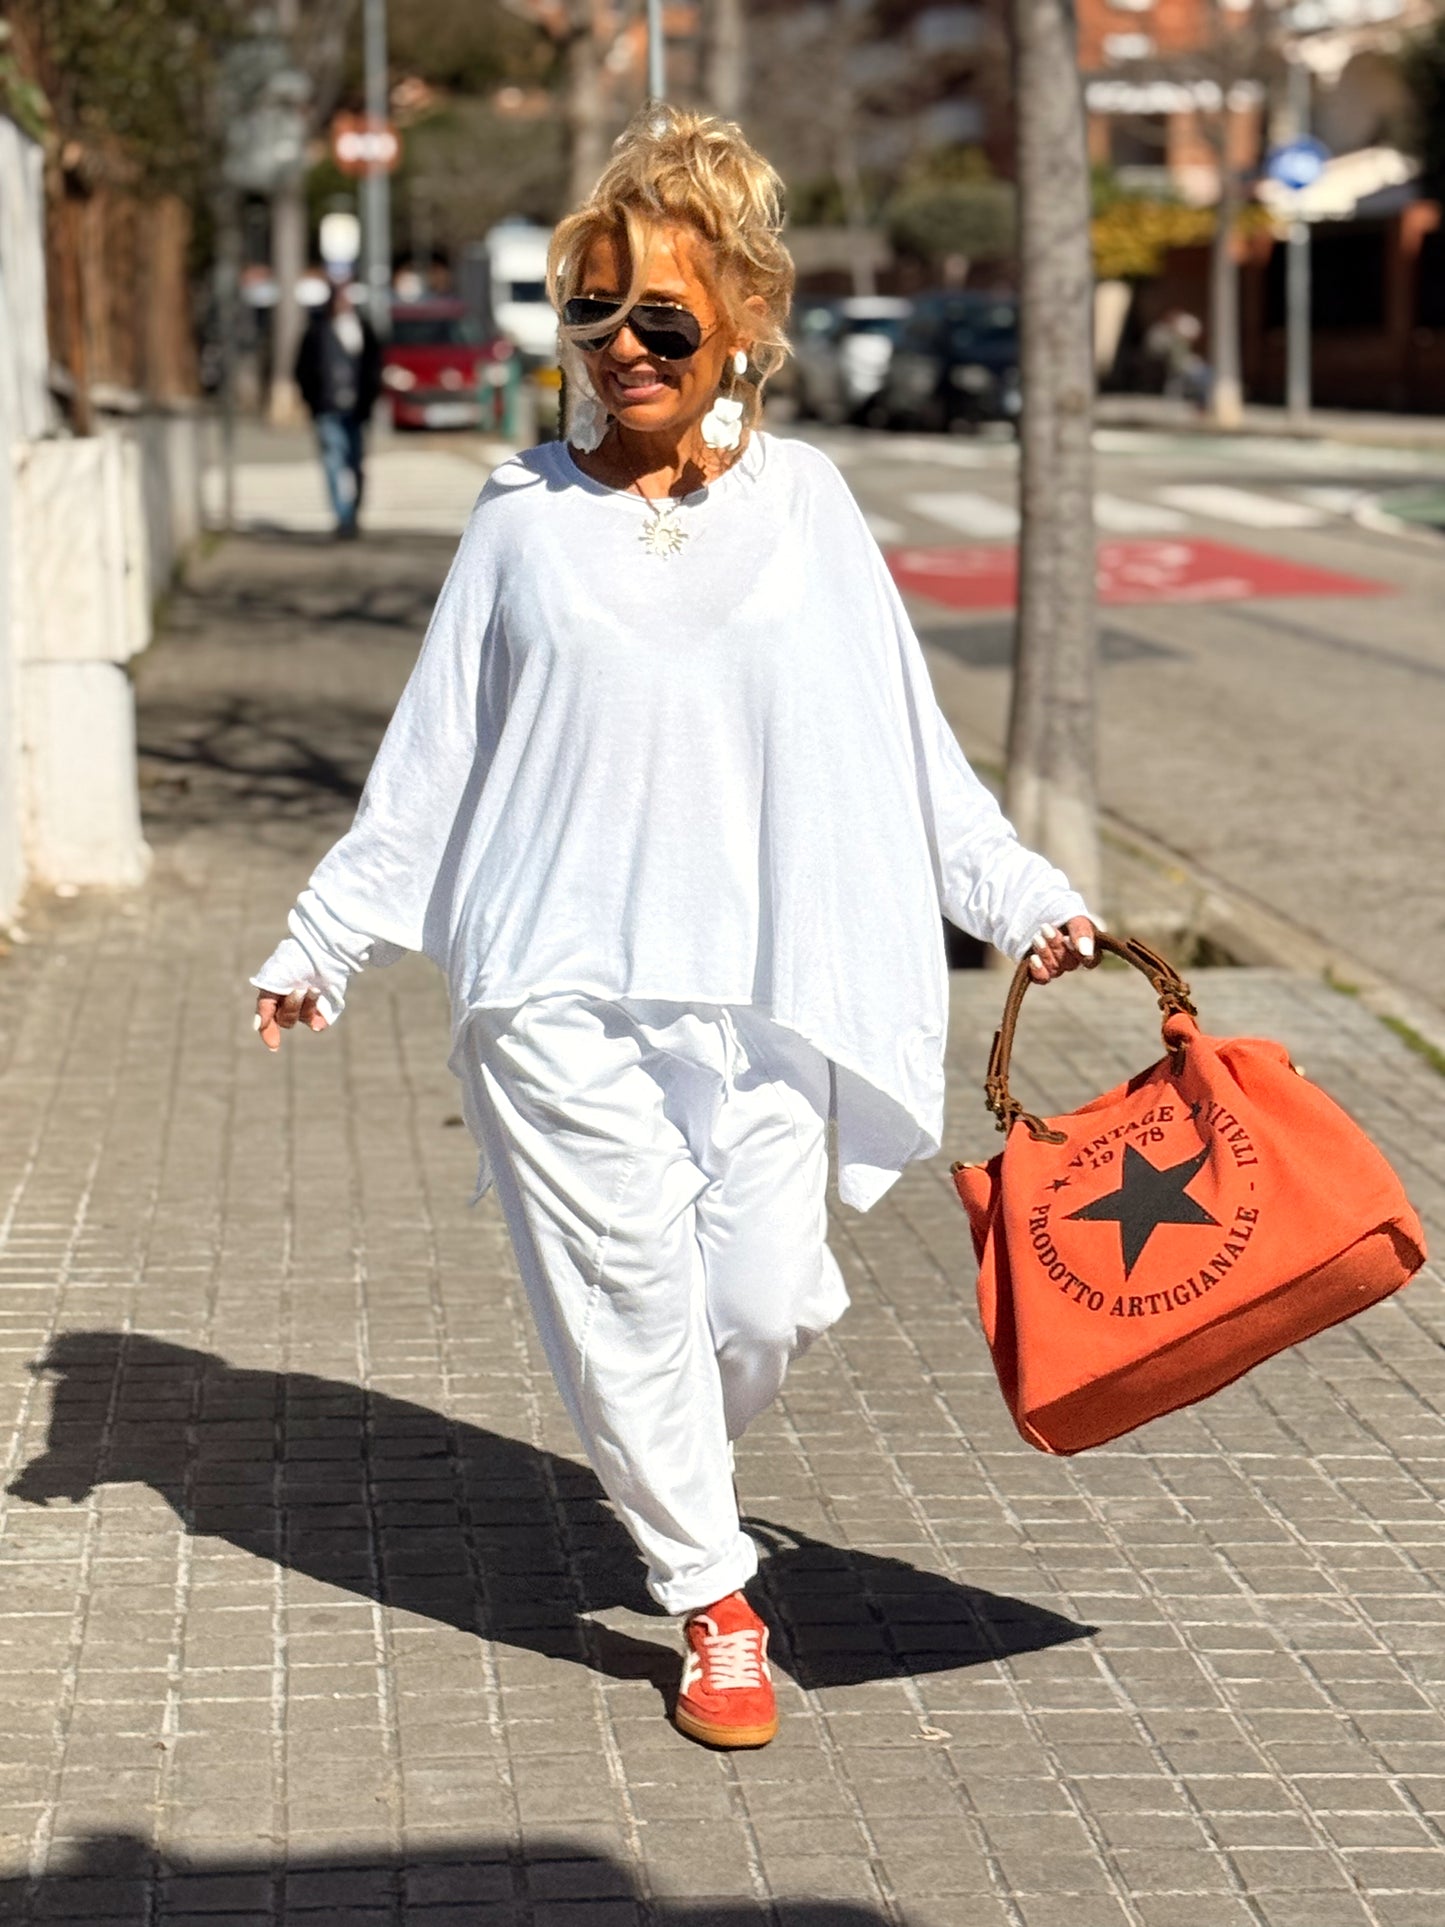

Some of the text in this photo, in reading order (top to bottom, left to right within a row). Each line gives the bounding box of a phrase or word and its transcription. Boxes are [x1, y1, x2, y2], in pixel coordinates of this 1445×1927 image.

[1068, 1106, 1174, 1167] VINTAGE
[1090, 1127, 1164, 1169] 19 78
[1029, 1203, 1104, 1311] PRODOTTO
[1109, 1206, 1259, 1317] ARTIGIANALE
